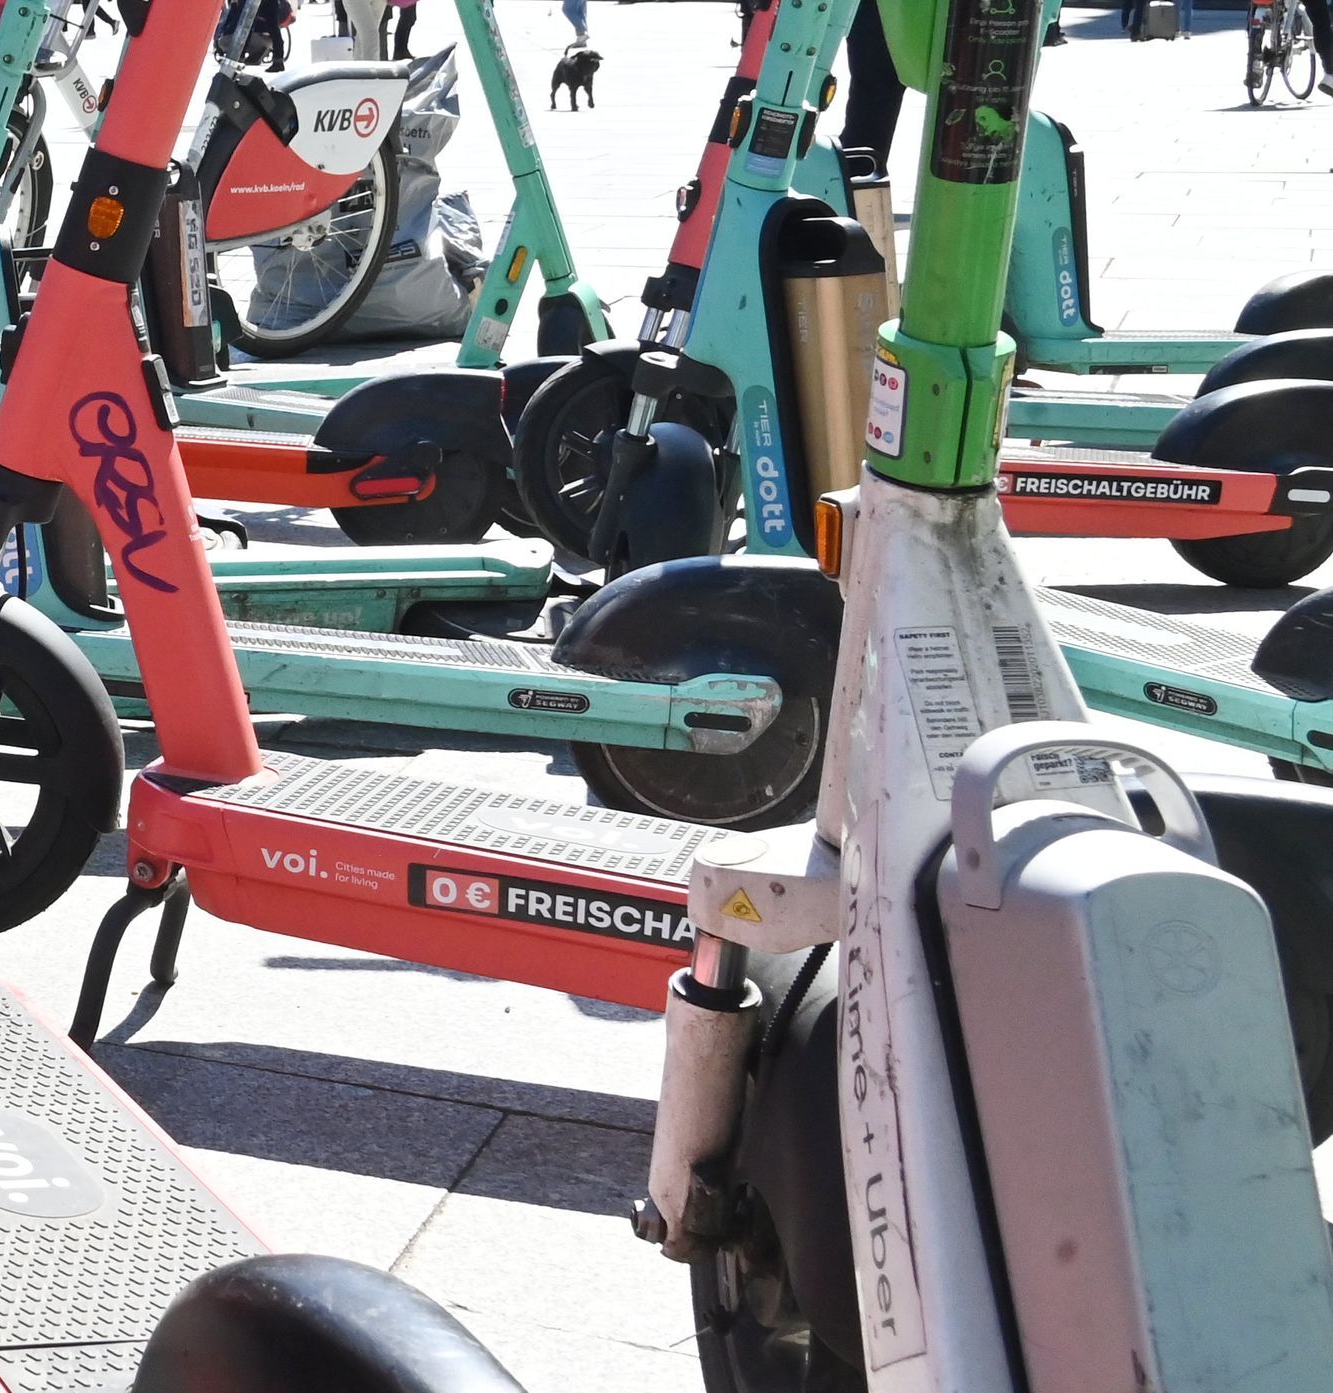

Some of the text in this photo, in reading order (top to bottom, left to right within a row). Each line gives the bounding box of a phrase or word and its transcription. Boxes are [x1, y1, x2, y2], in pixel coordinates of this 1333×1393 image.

[73, 78, 87, 101] KVB
[314, 110, 351, 133] KVB
[231, 181, 305, 193] www.kvb.koeln/rad
[1060, 270, 1076, 320] dott
[758, 399, 772, 447] TIER
[756, 456, 783, 534] dott
[1016, 476, 1211, 501] FREISCHALTGEBÜHR
[536, 700, 579, 709] SEGWAY
[1168, 696, 1209, 711] SEGWAY
[260, 847, 328, 879] voi.
[335, 861, 395, 880] Cities made
[335, 872, 378, 890] for living
[432, 876, 457, 904] 0
[465, 883, 491, 909] €
[864, 1174, 896, 1338] Uber
